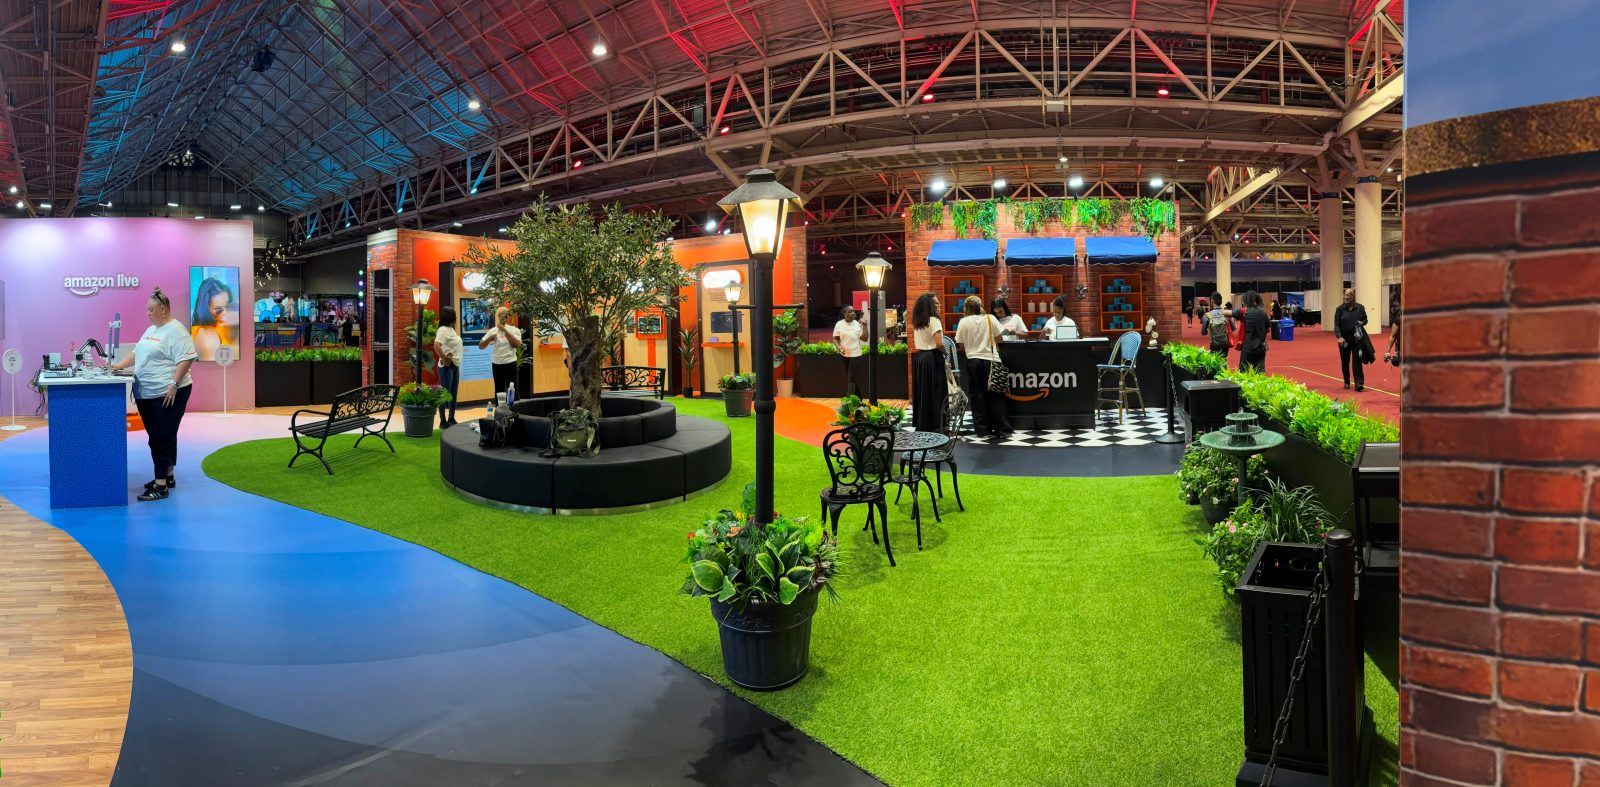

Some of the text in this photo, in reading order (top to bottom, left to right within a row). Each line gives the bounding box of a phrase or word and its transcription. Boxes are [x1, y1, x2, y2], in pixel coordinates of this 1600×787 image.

[64, 273, 139, 288] amazon live
[1007, 371, 1078, 389] mazon
